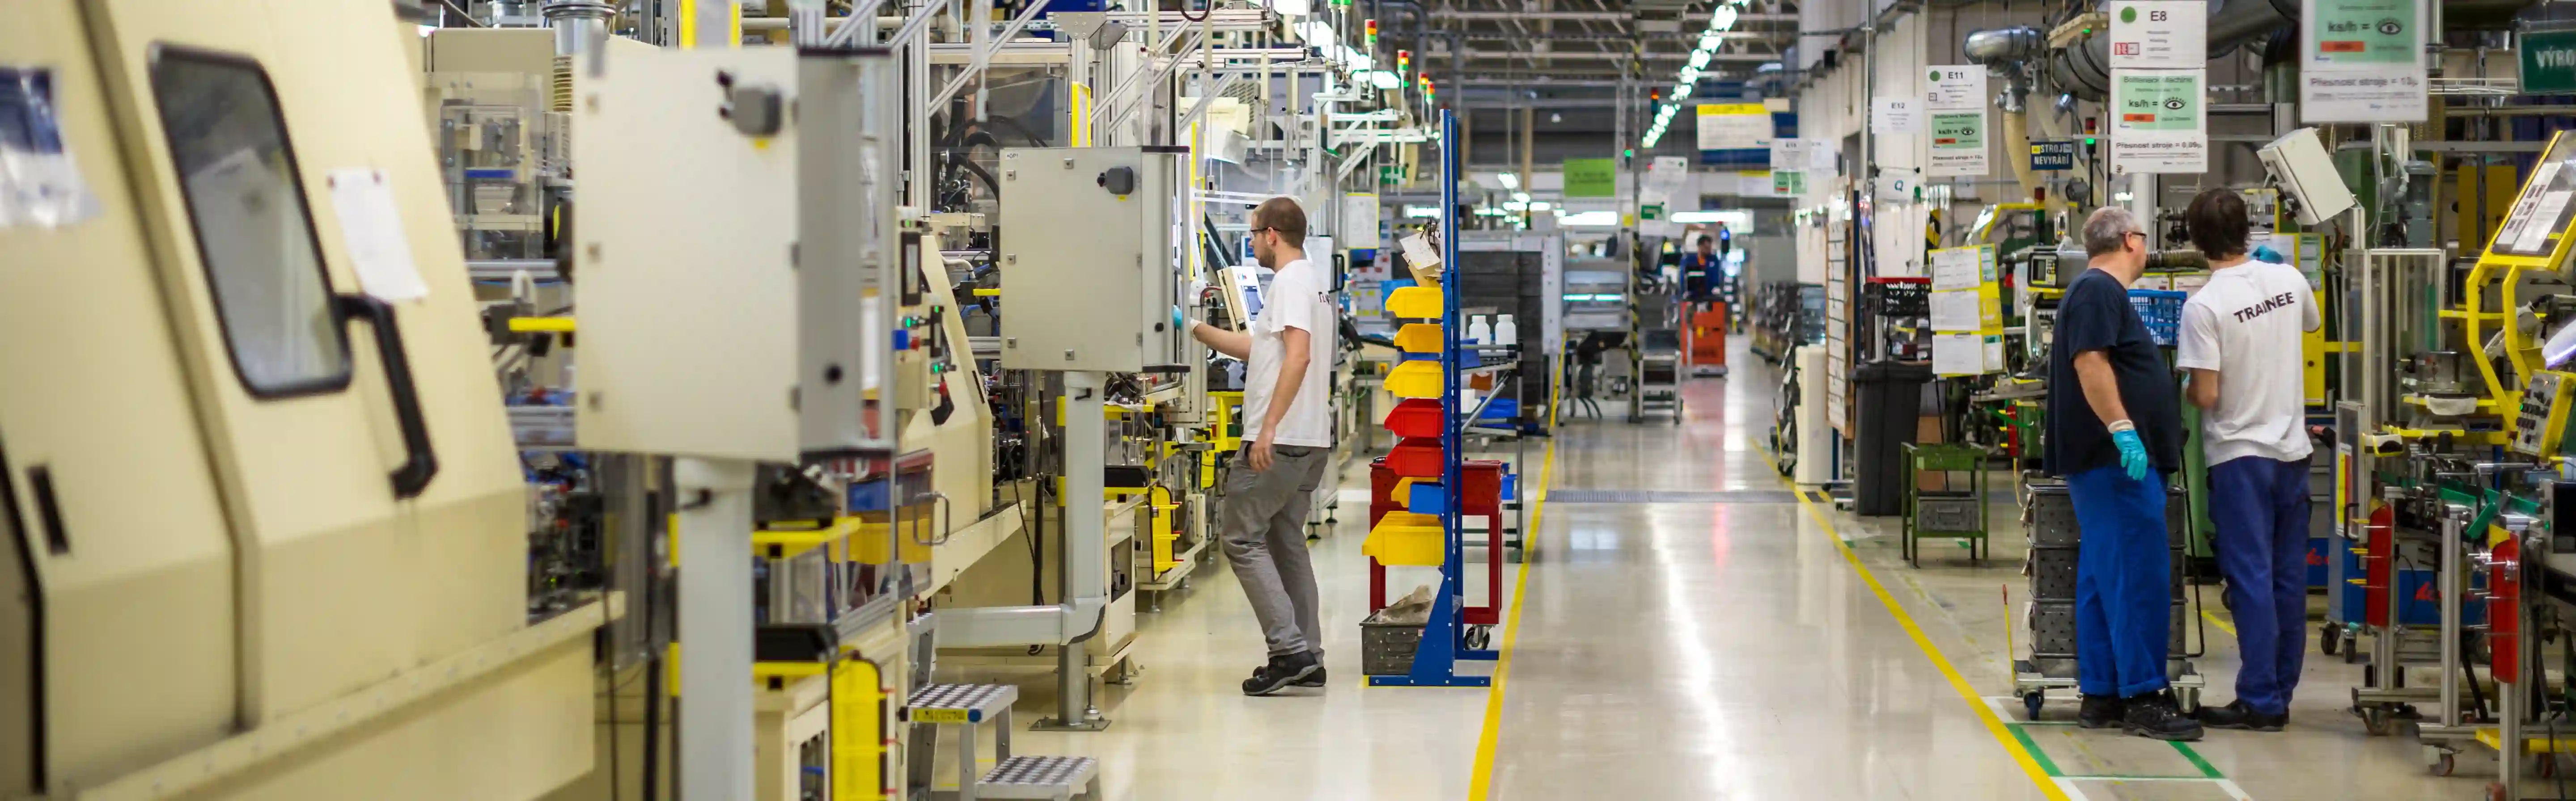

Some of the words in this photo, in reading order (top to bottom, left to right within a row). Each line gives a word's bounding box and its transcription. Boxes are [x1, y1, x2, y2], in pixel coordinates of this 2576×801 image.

[2150, 11, 2167, 21] E8
[2128, 99, 2148, 108] ks/h
[2040, 144, 2063, 153] STROJ
[2233, 291, 2295, 323] TRAINEE
